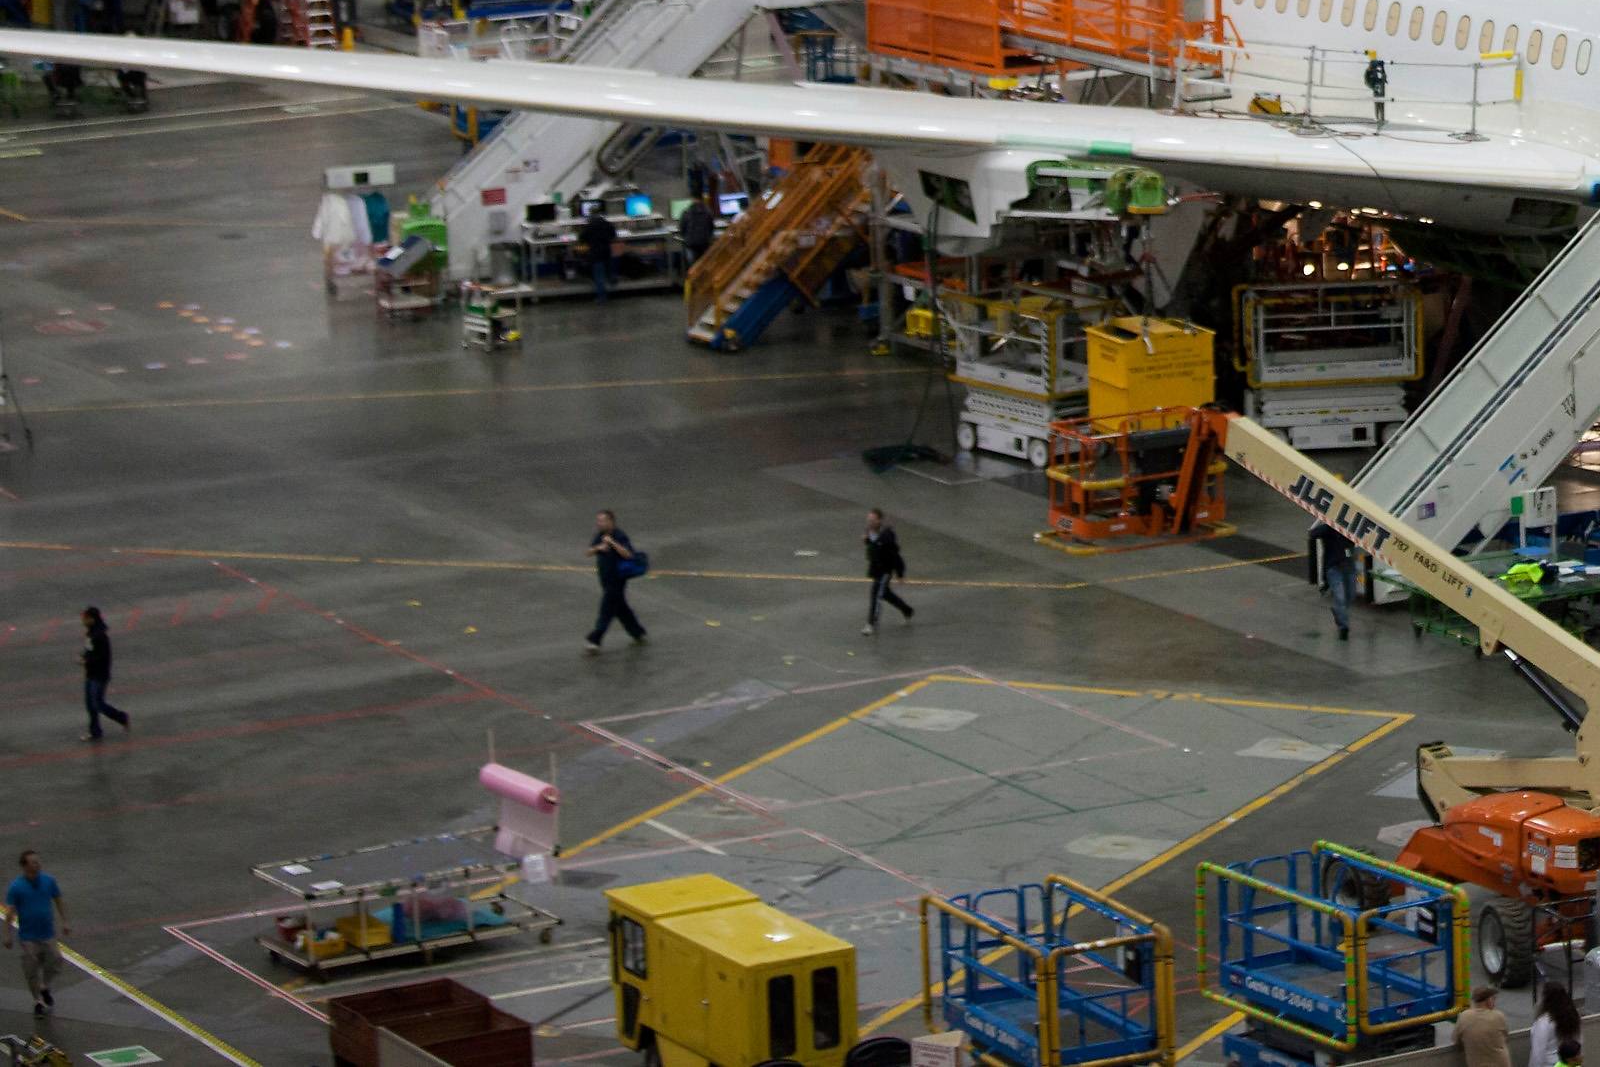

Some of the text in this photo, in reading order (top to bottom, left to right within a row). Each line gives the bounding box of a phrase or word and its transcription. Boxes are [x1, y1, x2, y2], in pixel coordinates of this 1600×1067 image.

[1289, 475, 1391, 551] JLG LIFT
[1441, 571, 1464, 590] LIFT
